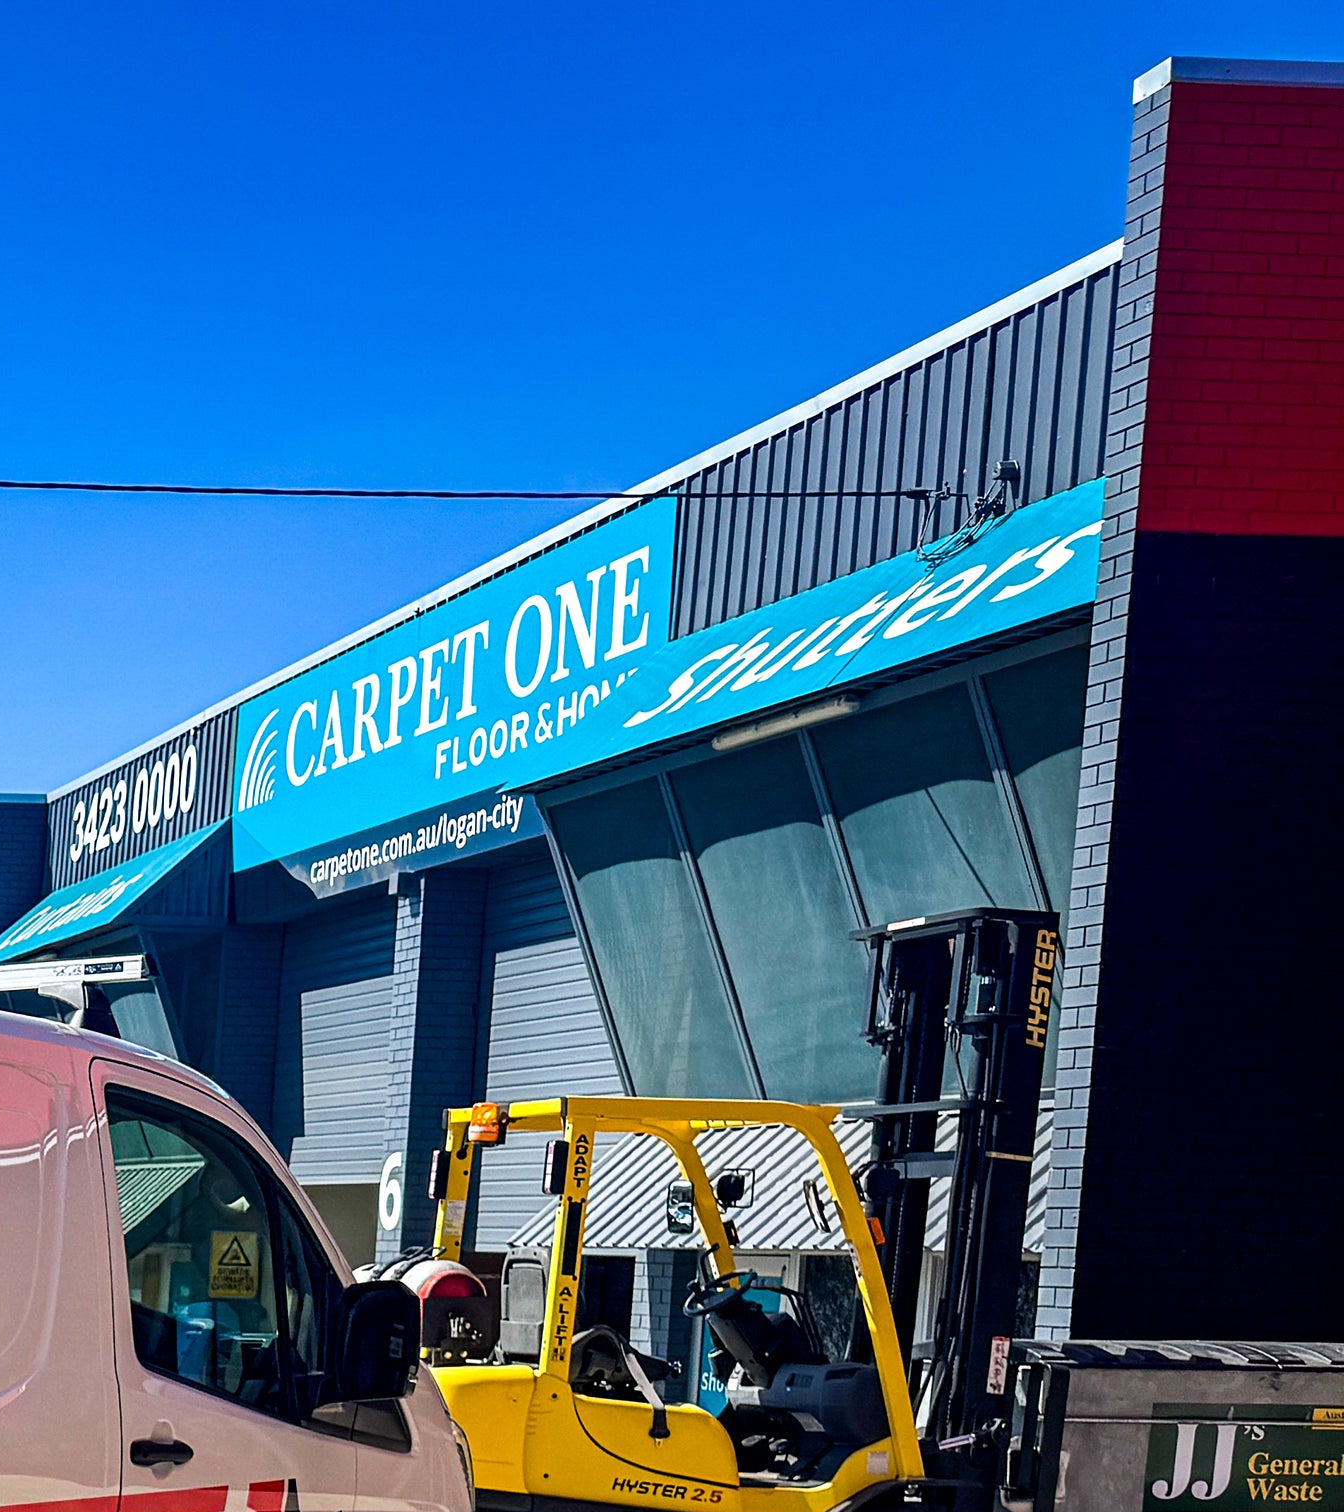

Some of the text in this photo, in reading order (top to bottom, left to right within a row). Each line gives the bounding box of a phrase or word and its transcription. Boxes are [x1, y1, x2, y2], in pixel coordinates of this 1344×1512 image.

[622, 520, 1105, 728] Shutters
[286, 545, 650, 786] CARPET ONE
[434, 711, 530, 780] FLOOR
[70, 744, 197, 862] 3423 0000
[310, 794, 524, 887] carpetone.com.au/logan-city
[1026, 929, 1057, 1049] HYSTER
[378, 1151, 402, 1231] 6
[573, 1133, 590, 1188] ADAPT
[612, 1477, 723, 1504] HYSTER 2.5
[1247, 1478, 1323, 1501] Waste
[1248, 1452, 1344, 1476] General
